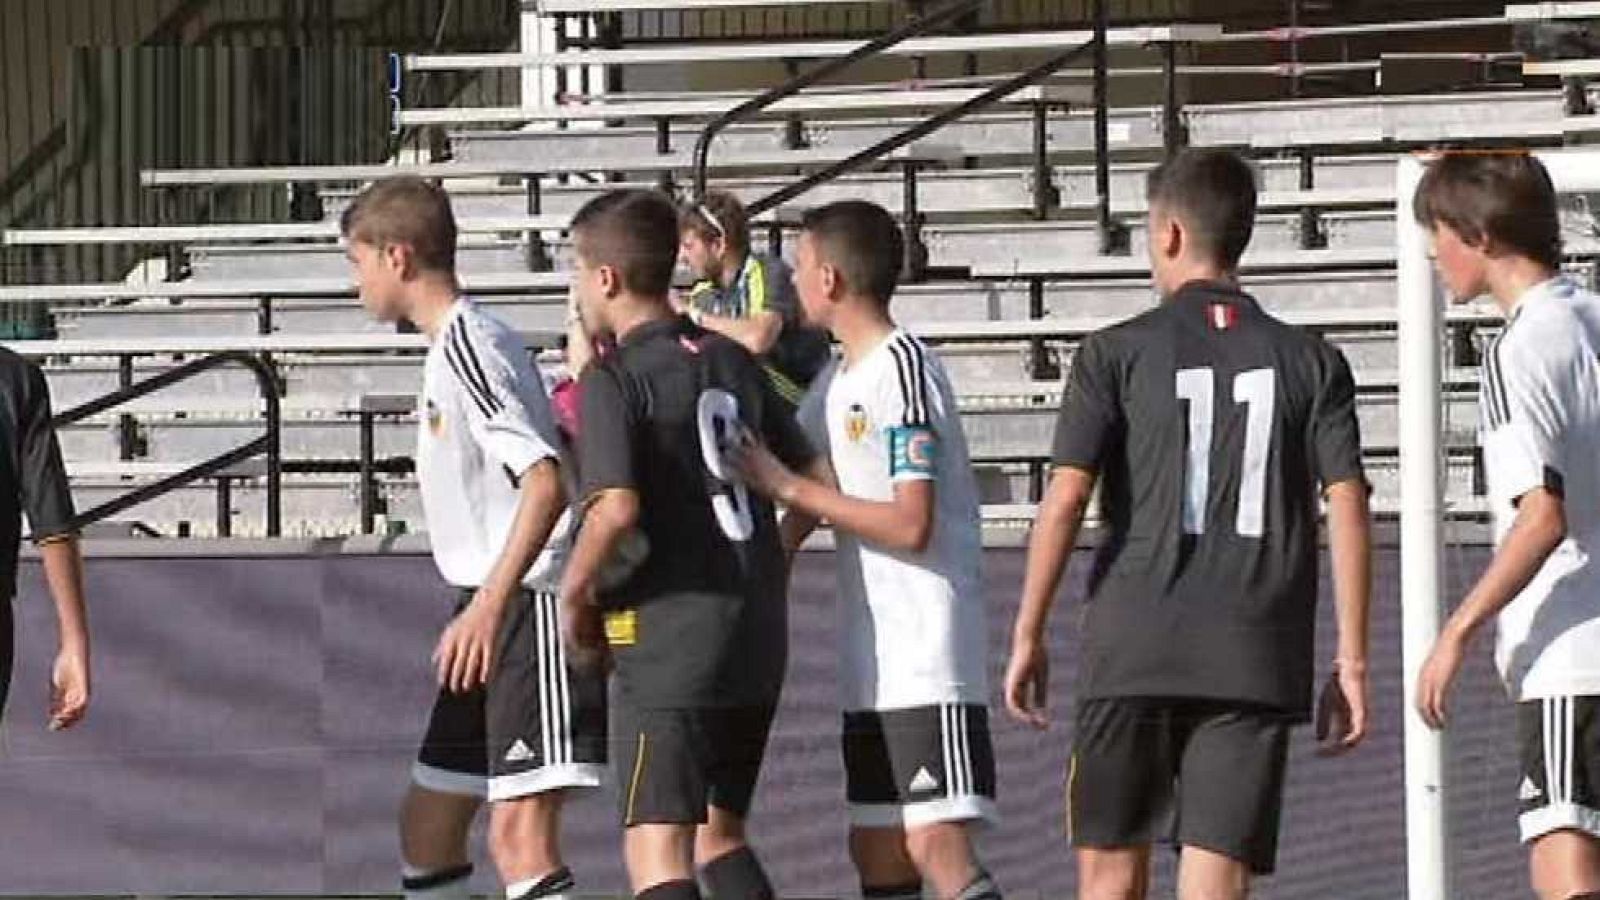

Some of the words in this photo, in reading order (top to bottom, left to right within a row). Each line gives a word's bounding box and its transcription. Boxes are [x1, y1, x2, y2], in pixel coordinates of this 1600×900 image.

[697, 388, 754, 541] 9
[906, 431, 935, 466] C
[1175, 367, 1275, 537] 11
